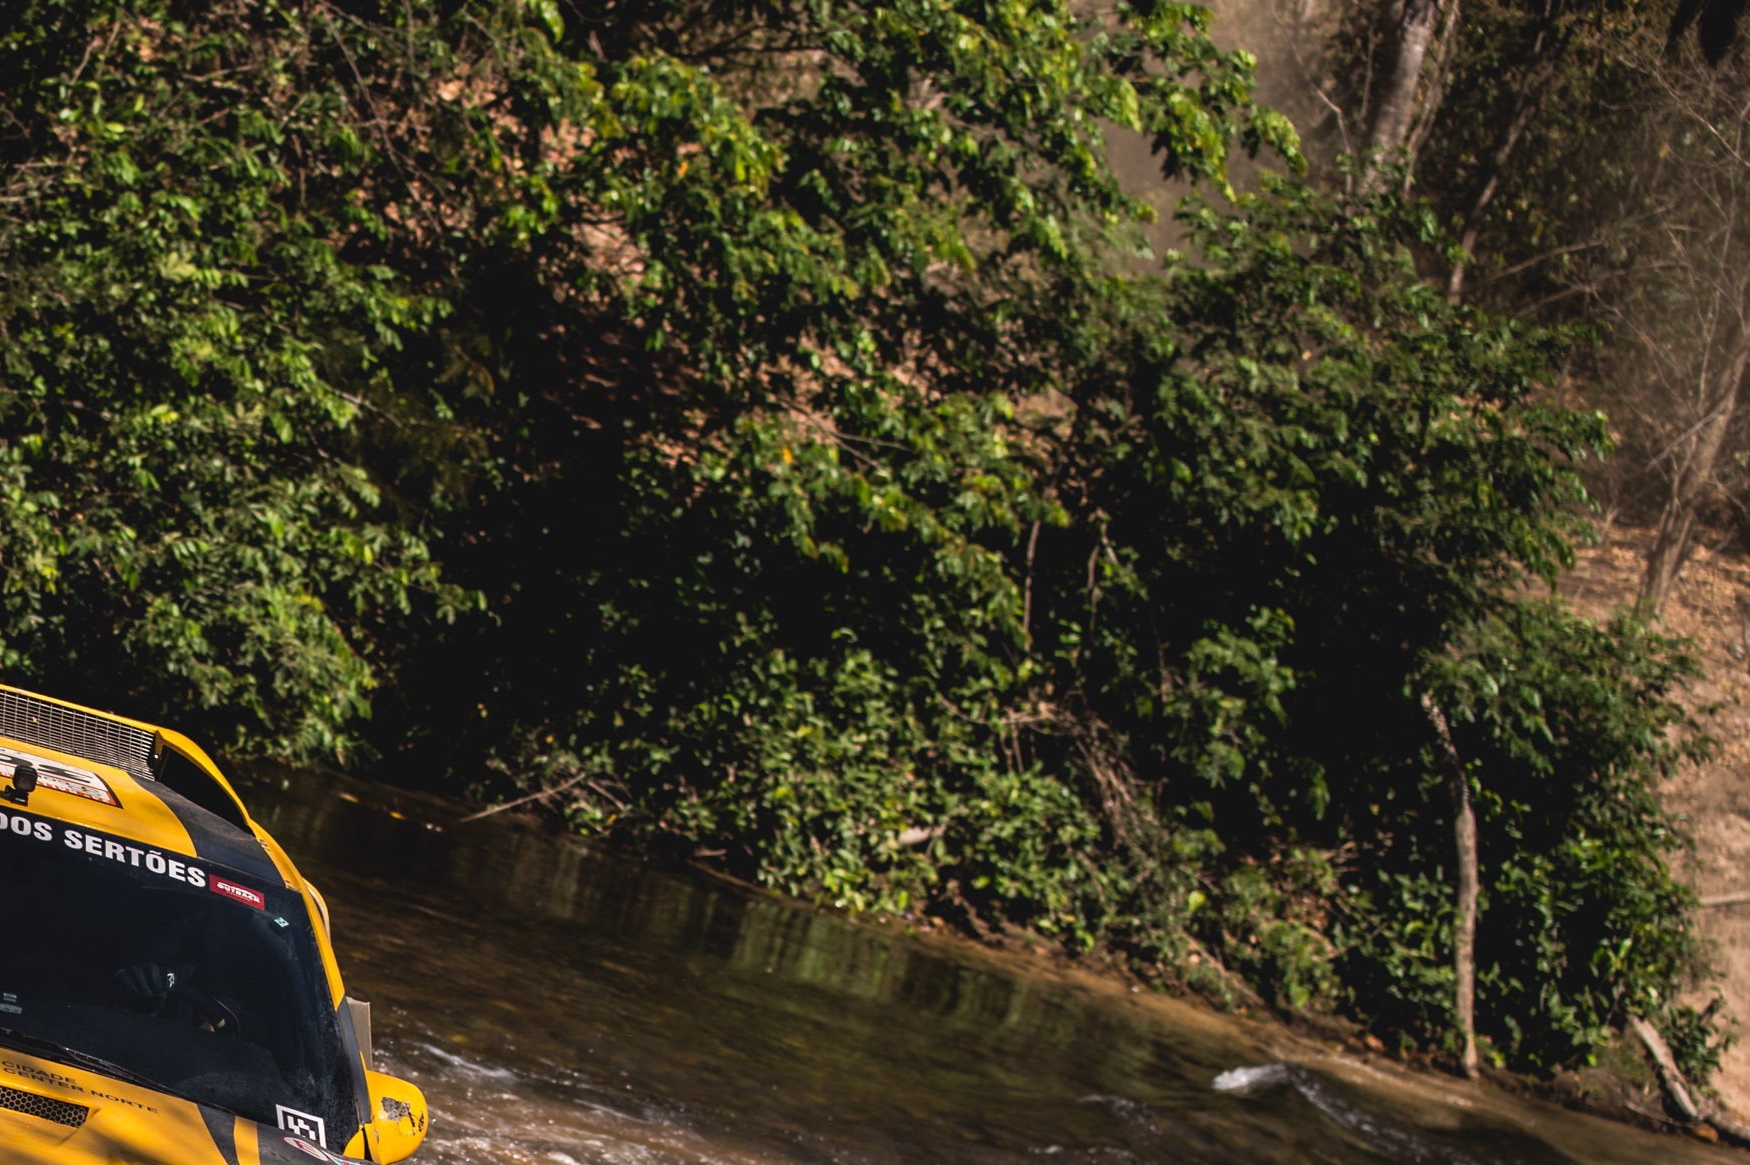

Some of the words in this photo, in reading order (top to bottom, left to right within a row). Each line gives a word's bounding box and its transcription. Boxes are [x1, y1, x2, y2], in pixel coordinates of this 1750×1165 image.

[64, 829, 207, 888] SERTÕES
[1, 1060, 78, 1085] CIDADE
[3, 1067, 85, 1093] CENTER
[90, 1089, 159, 1114] NORTE
